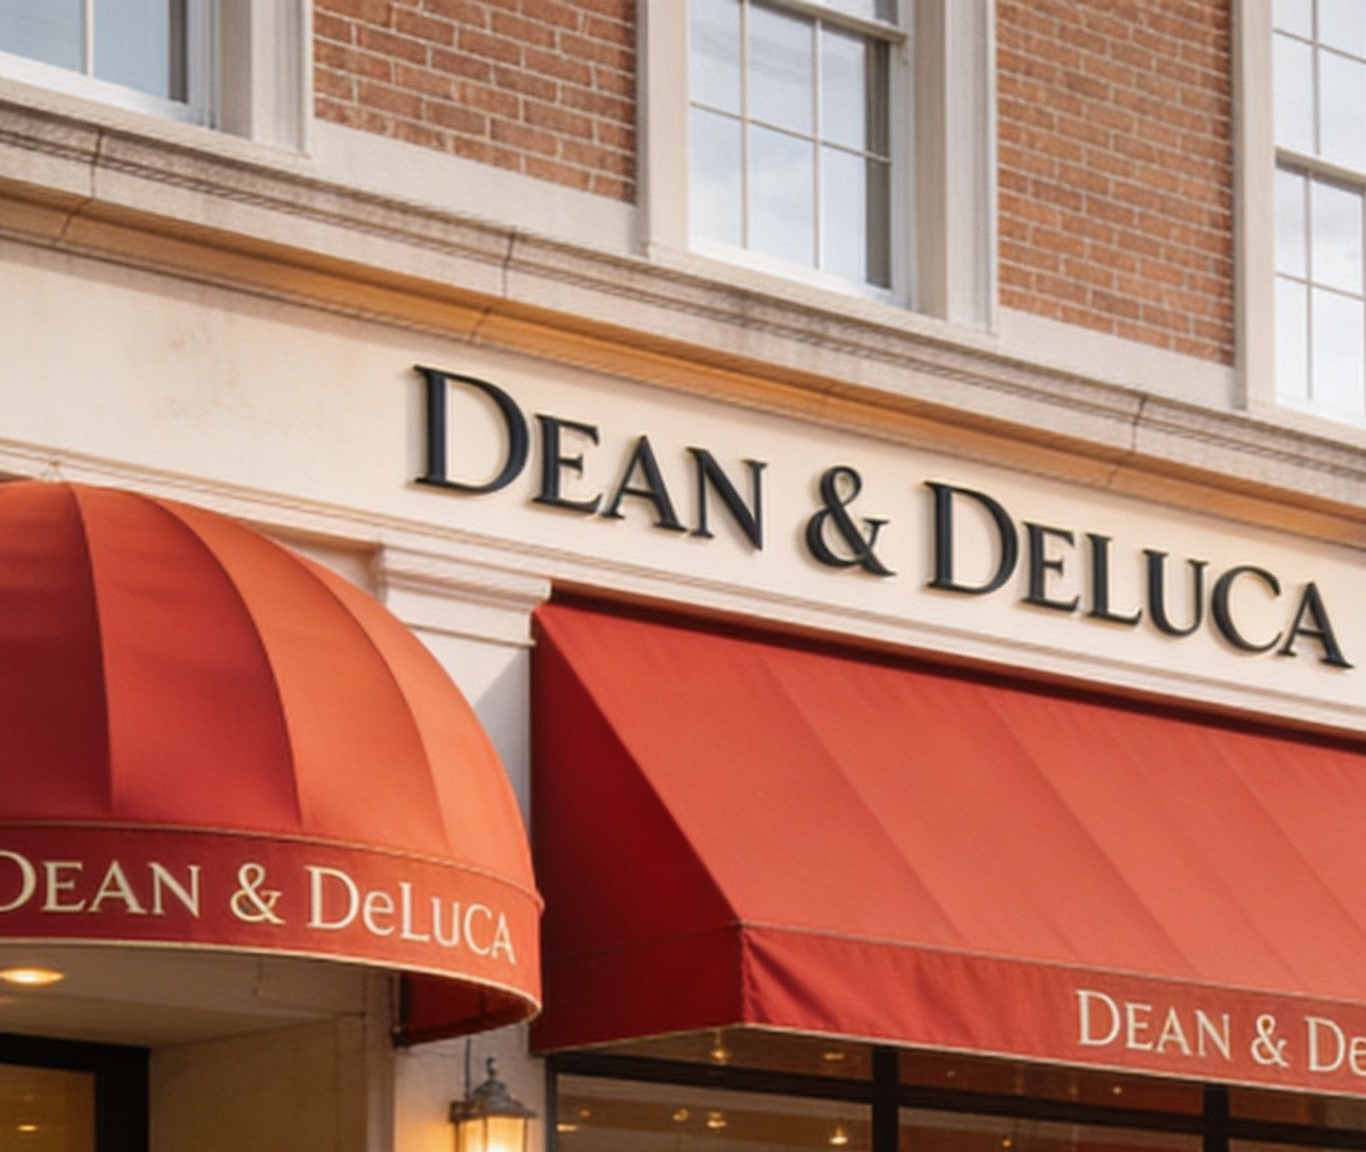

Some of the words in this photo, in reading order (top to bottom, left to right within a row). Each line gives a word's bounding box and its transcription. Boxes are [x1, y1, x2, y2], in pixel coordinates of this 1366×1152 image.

[414, 365, 768, 550] DEAN
[805, 465, 895, 577] &
[230, 863, 286, 924] &
[1076, 989, 1232, 1060] DEAN
[1250, 1014, 1289, 1068] &
